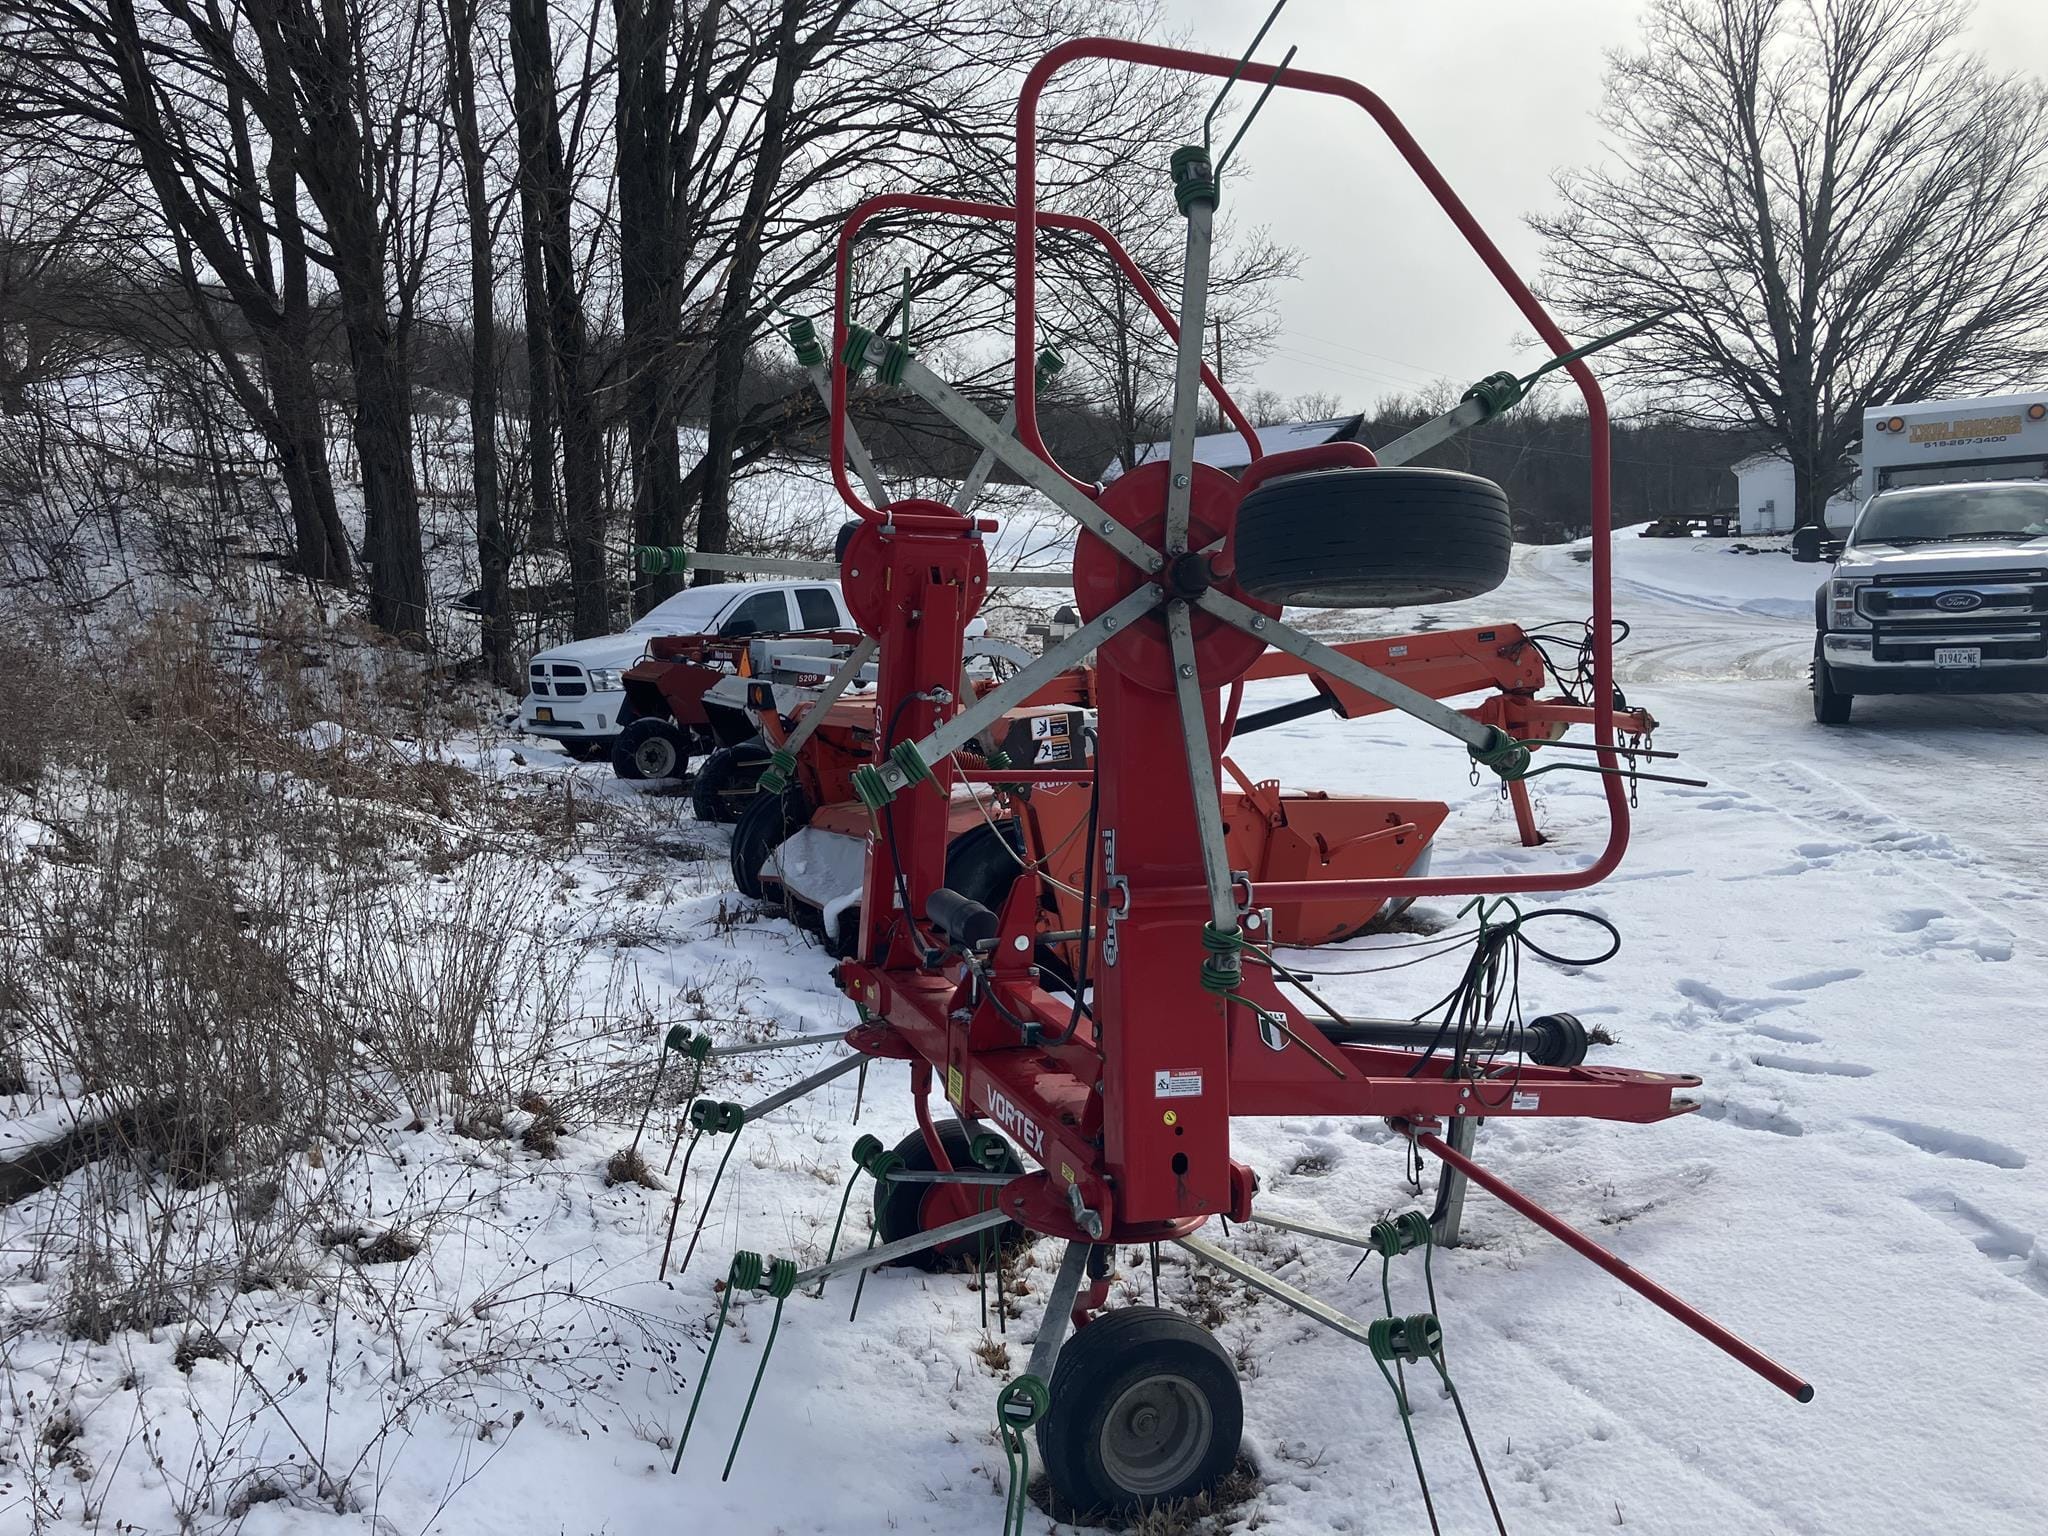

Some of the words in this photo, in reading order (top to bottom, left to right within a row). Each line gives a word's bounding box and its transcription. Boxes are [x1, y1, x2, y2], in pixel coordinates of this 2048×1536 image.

[1945, 596, 1972, 607] Ford
[798, 674, 818, 682] 5209
[987, 1083, 1044, 1159] VORTEX
